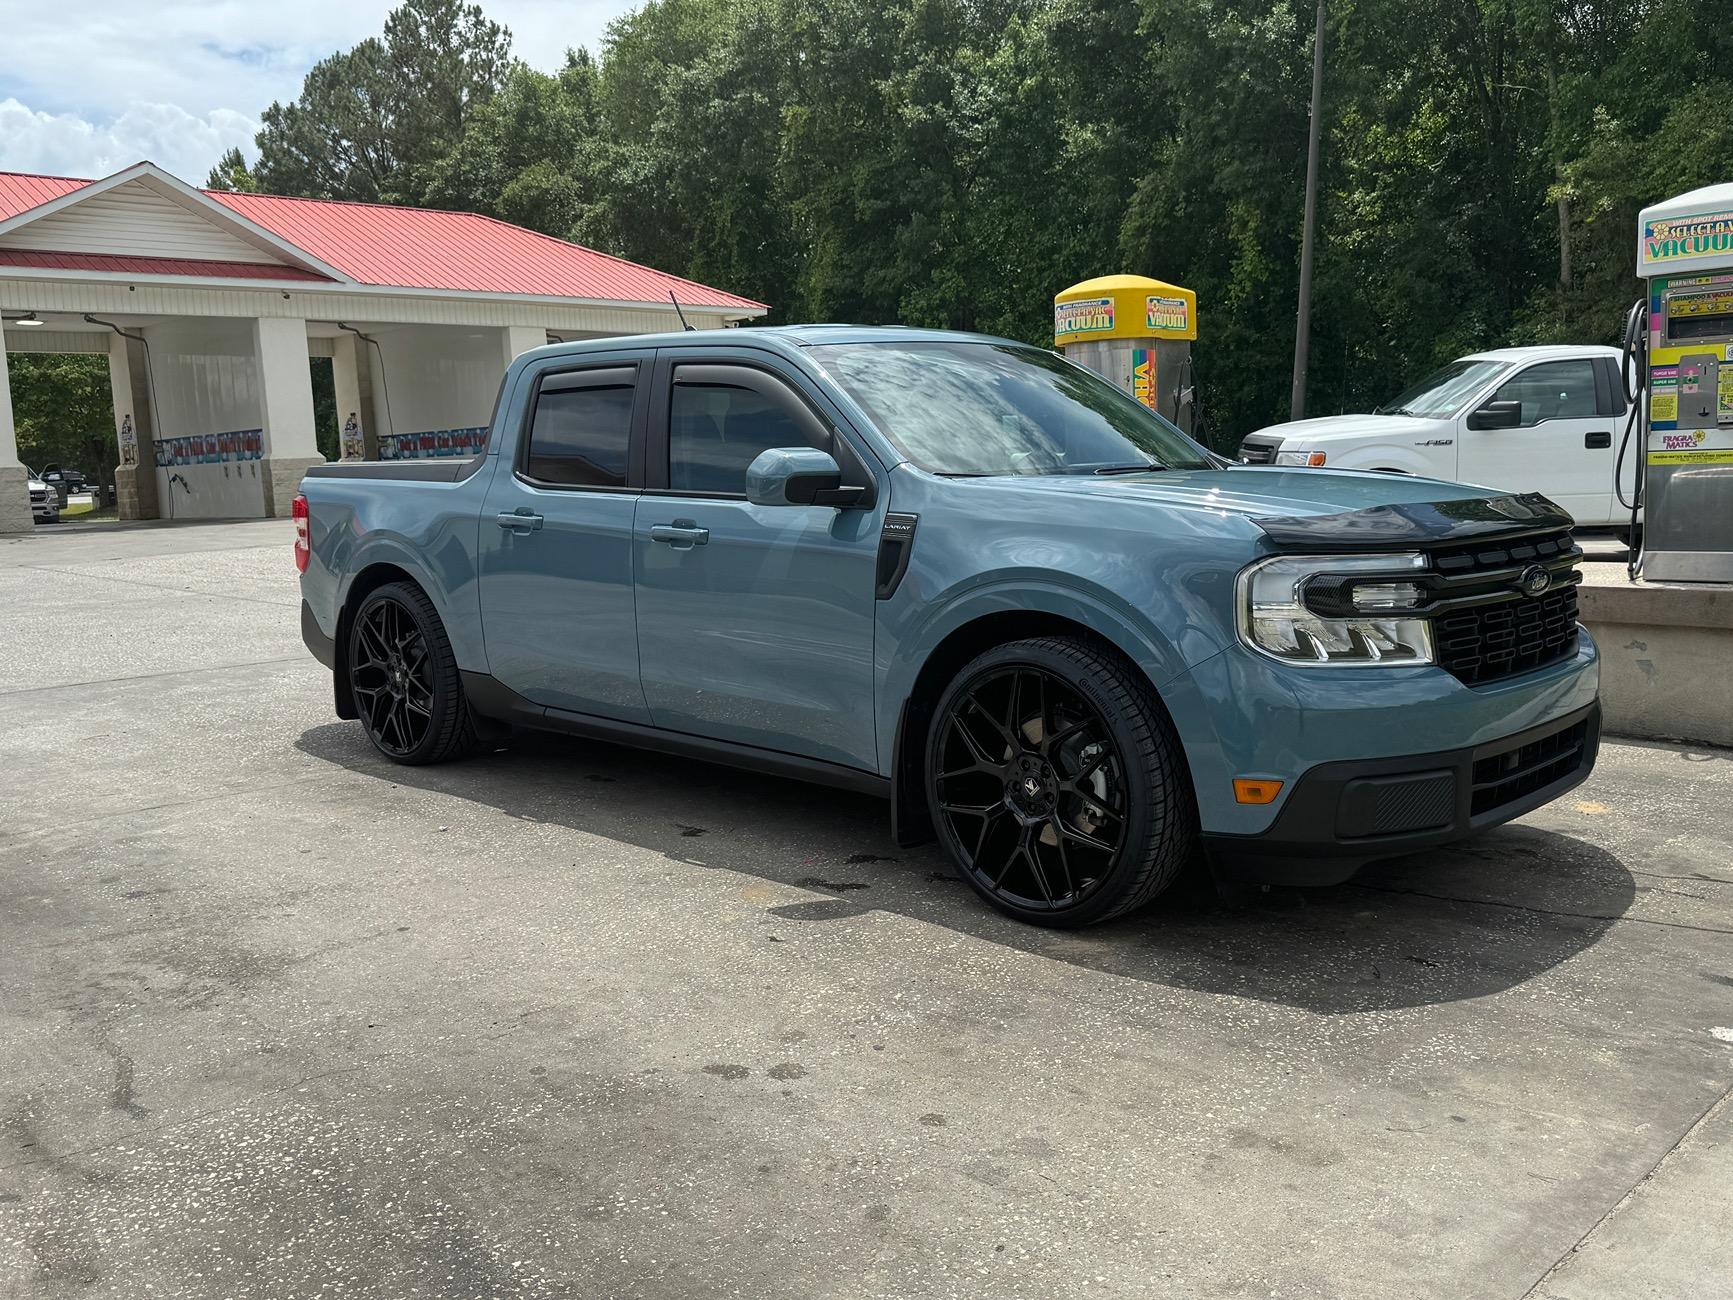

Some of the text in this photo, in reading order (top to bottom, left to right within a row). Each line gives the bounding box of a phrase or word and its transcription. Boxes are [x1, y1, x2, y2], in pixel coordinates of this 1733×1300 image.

[1693, 216, 1713, 224] SPOT
[1671, 223, 1713, 238] SELECT
[1649, 232, 1733, 258] VACUU
[1663, 435, 1693, 443] FRAGRA
[1666, 441, 1697, 449] MATICS
